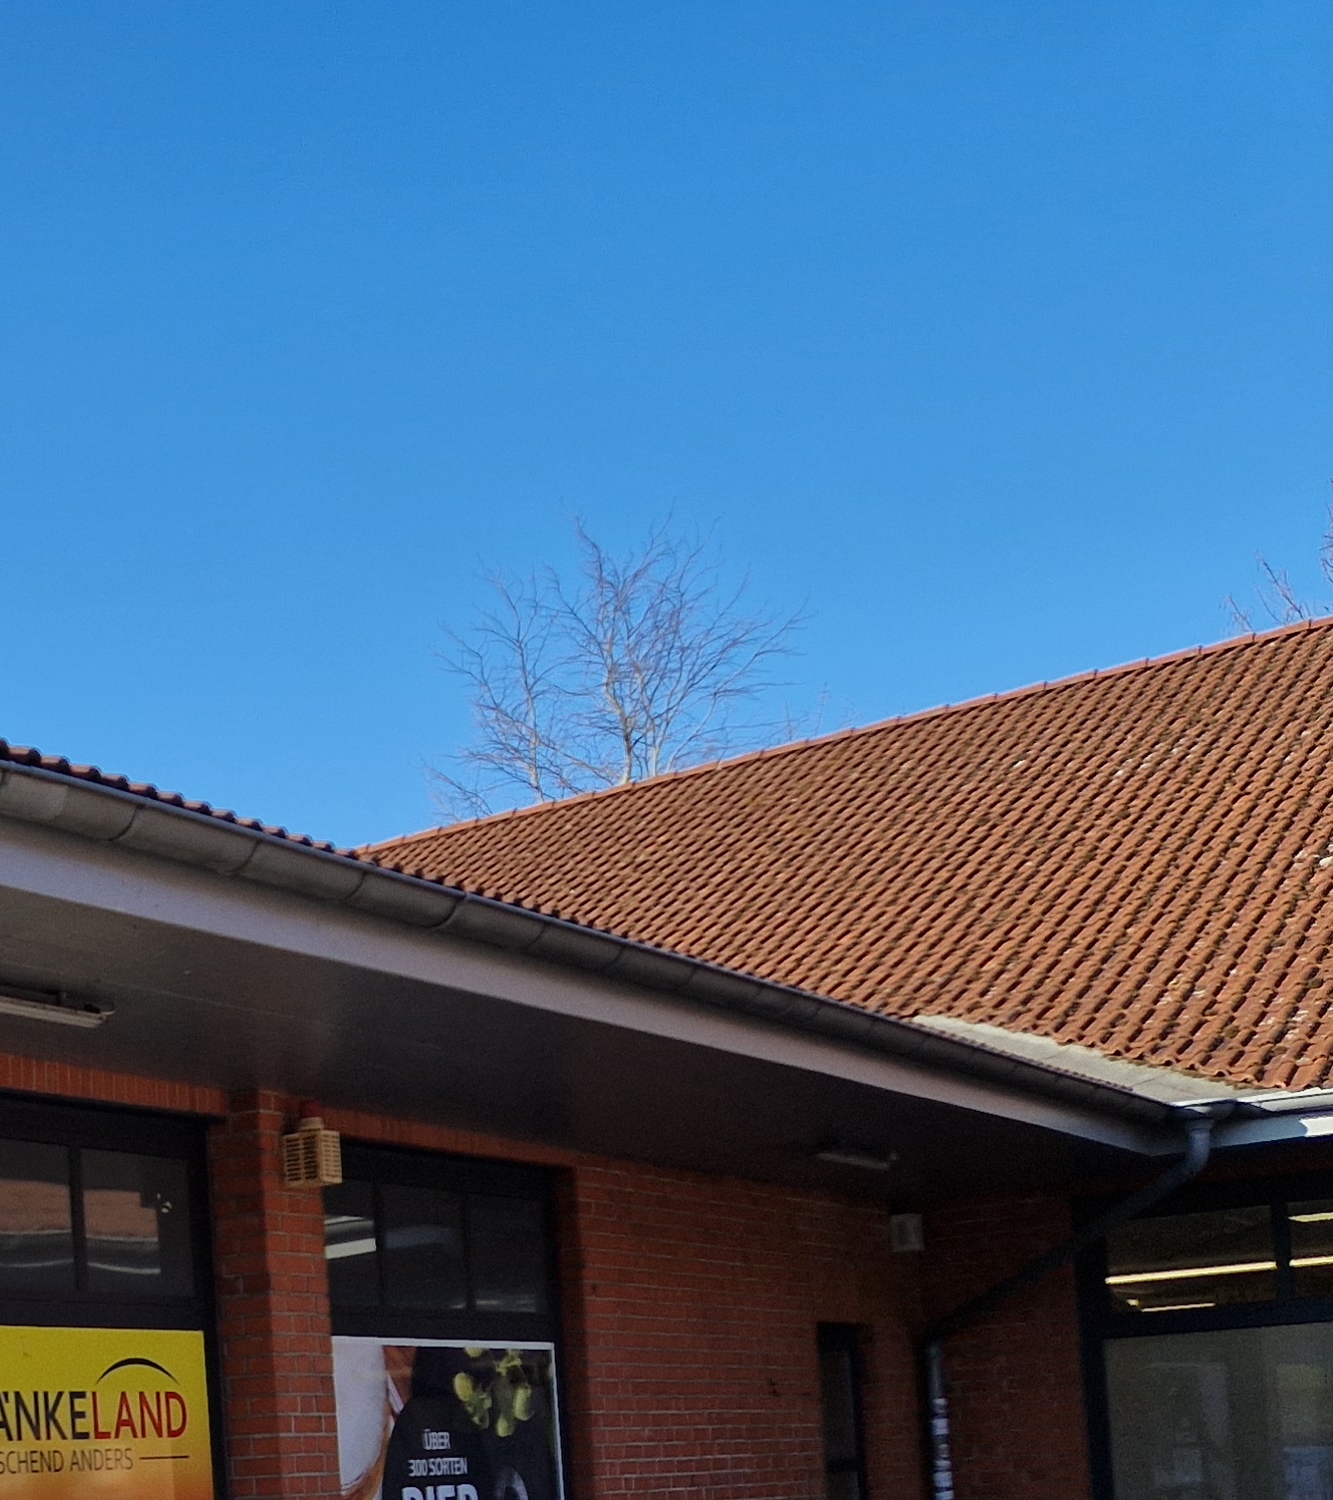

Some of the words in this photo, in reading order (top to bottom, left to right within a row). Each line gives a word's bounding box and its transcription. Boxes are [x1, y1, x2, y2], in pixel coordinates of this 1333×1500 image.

[422, 1429, 451, 1450] ÜBER
[68, 1448, 133, 1473] ANDERS
[408, 1459, 428, 1477] 300
[428, 1457, 468, 1476] SORTEN
